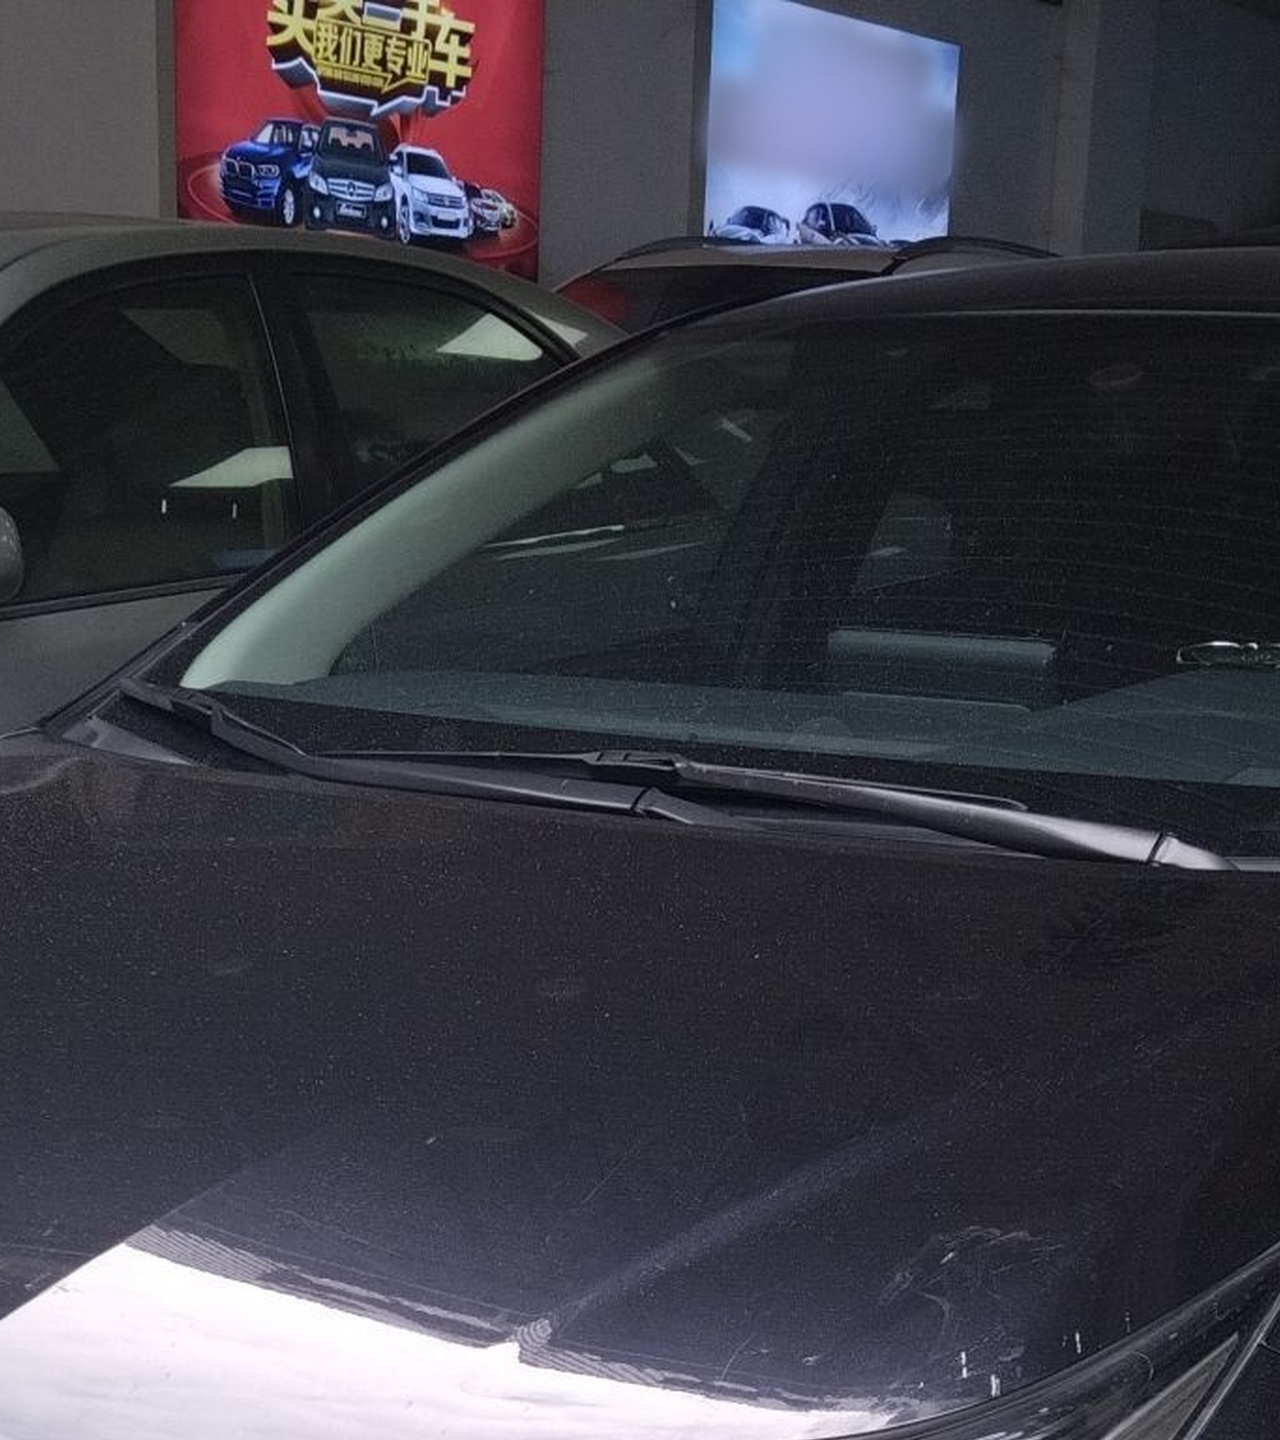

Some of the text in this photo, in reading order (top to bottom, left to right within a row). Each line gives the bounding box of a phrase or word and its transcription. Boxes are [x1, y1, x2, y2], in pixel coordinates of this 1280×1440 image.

[316, 22, 429, 79] 我们更专业
